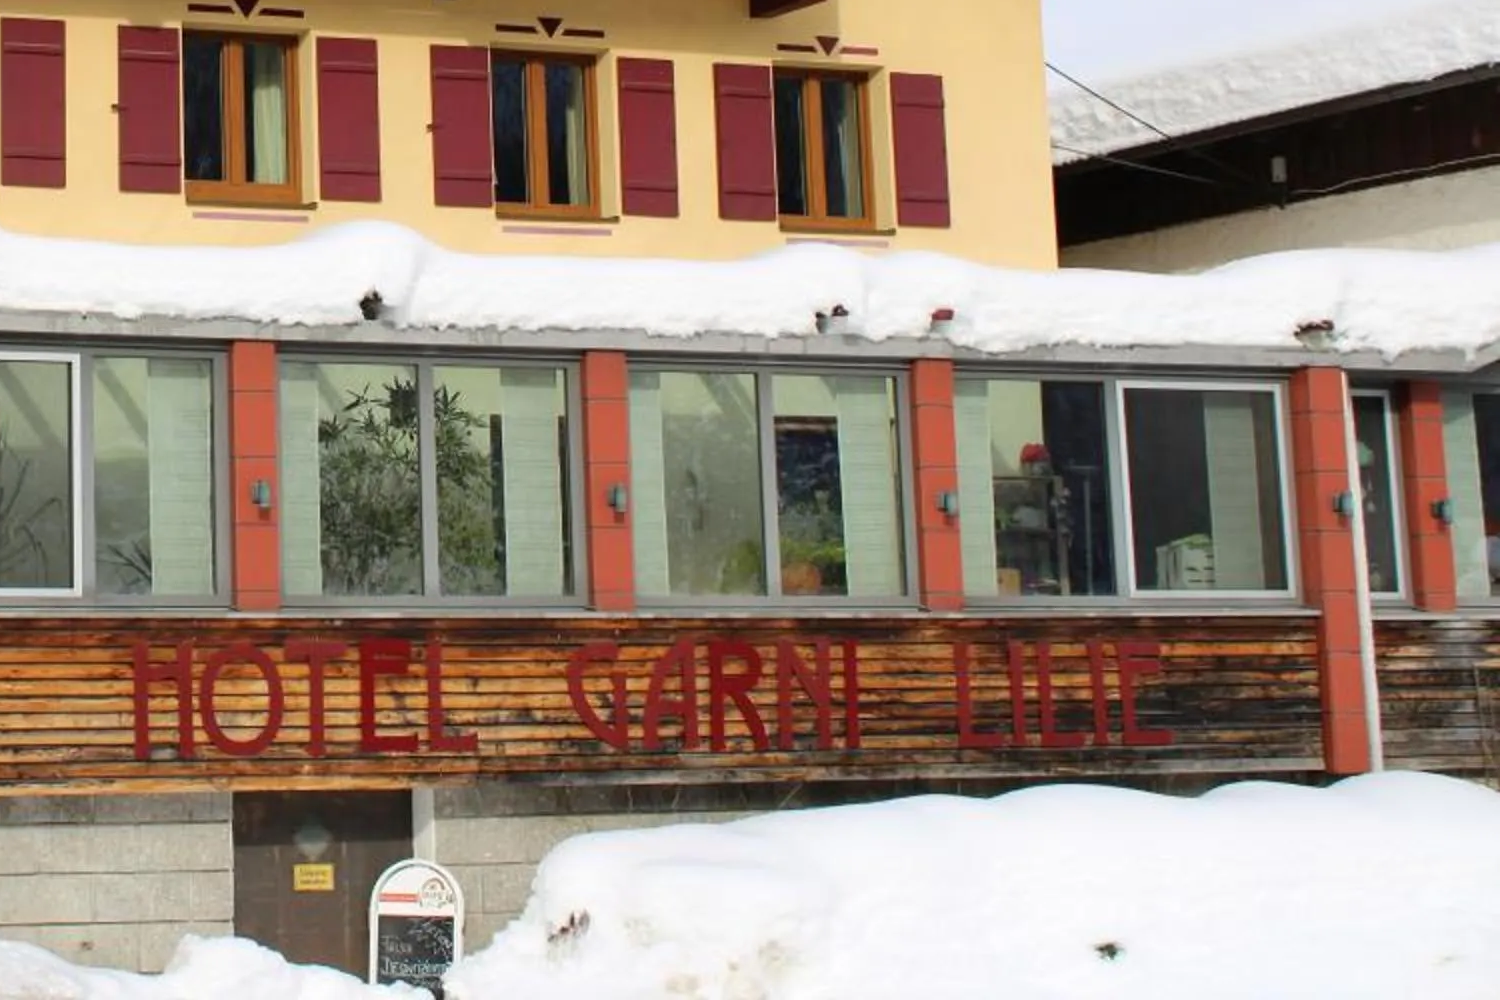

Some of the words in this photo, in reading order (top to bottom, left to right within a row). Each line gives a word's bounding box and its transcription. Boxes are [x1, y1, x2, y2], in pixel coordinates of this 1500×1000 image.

[133, 636, 478, 760] HOTEL
[566, 638, 861, 752] GARNI
[954, 639, 1173, 748] LILIE
